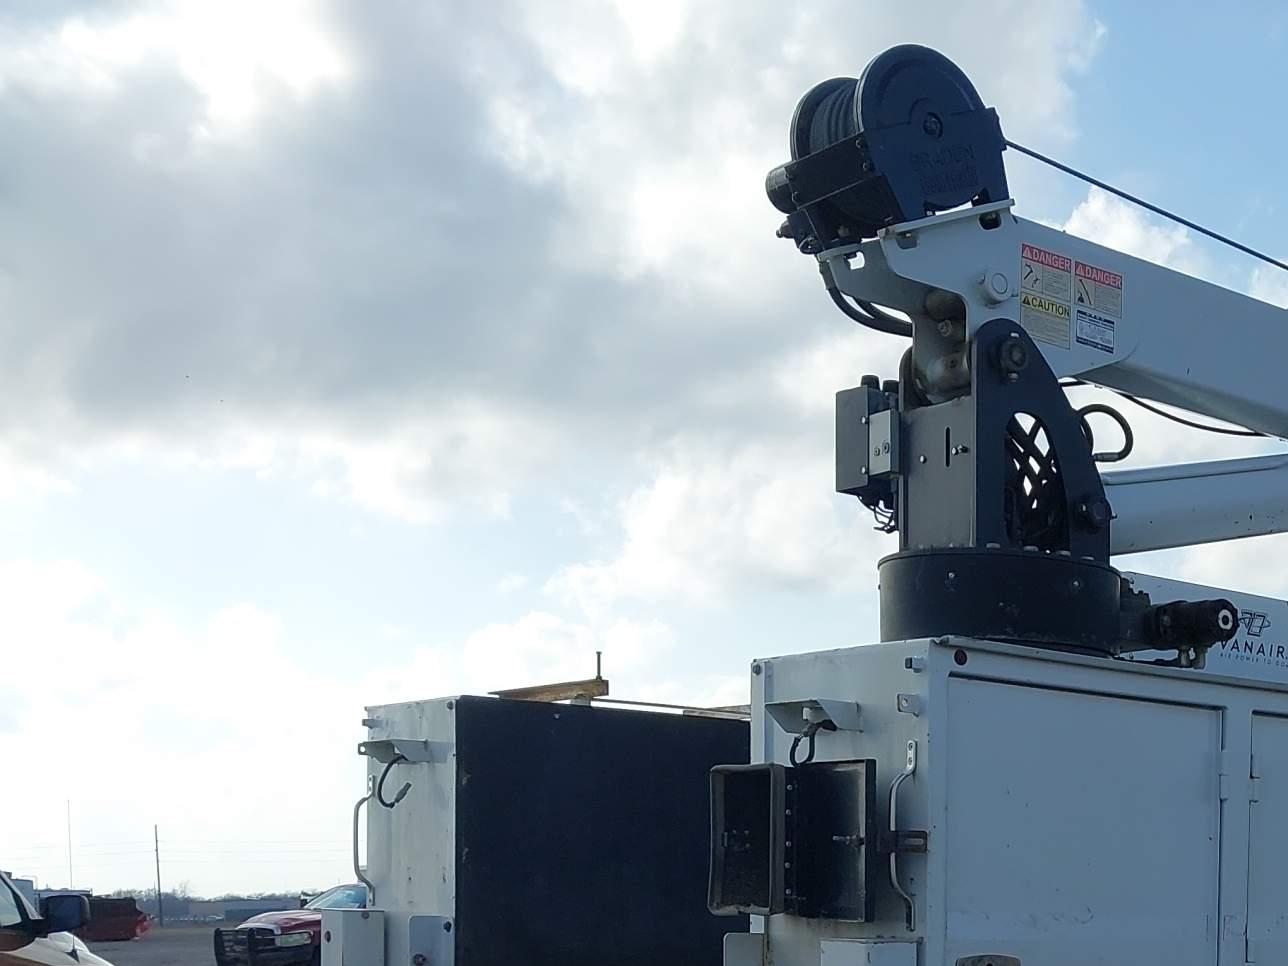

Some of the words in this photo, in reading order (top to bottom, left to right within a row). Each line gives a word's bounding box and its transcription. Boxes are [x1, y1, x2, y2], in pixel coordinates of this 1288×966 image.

[1032, 249, 1071, 271] DANGER
[1084, 267, 1122, 288] DANGER
[1031, 295, 1070, 317] CAUTION
